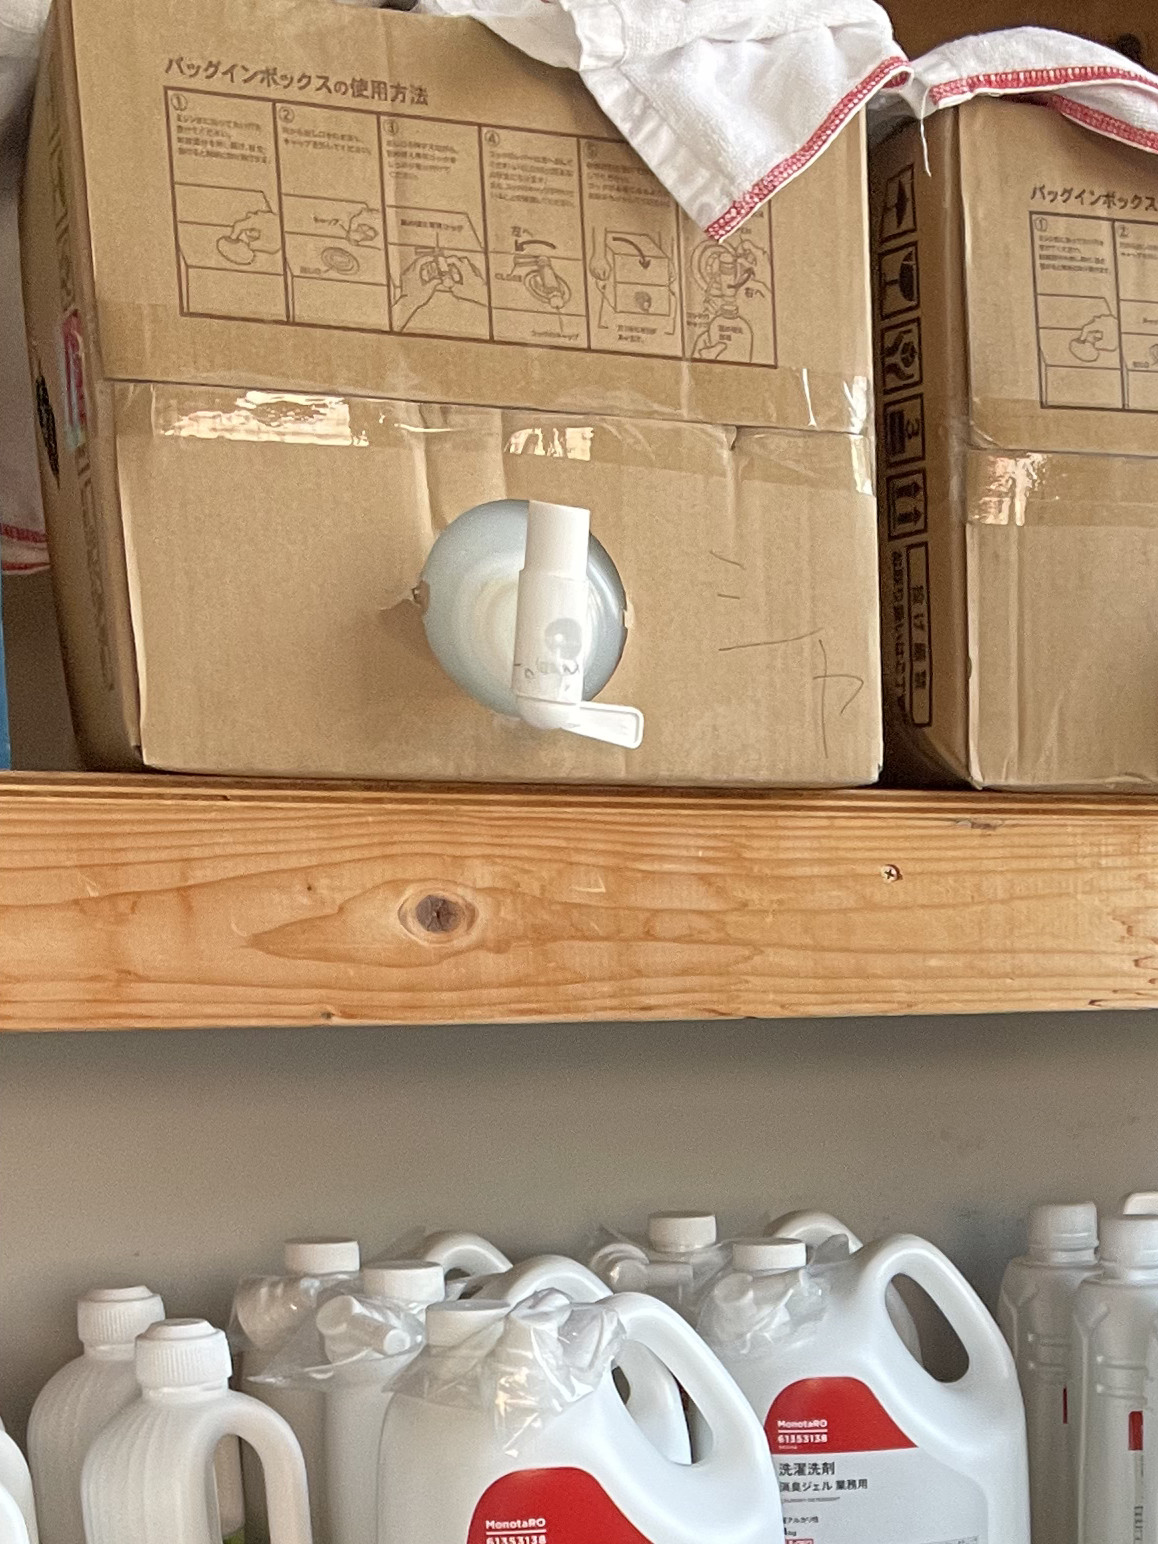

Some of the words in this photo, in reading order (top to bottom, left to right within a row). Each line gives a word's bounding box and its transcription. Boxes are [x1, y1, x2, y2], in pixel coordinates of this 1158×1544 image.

[164, 57, 429, 106] バッグインボックスの使用方法
[779, 1462, 835, 1476] 洗濯洗剤
[485, 1518, 546, 1530] MonotaRO
